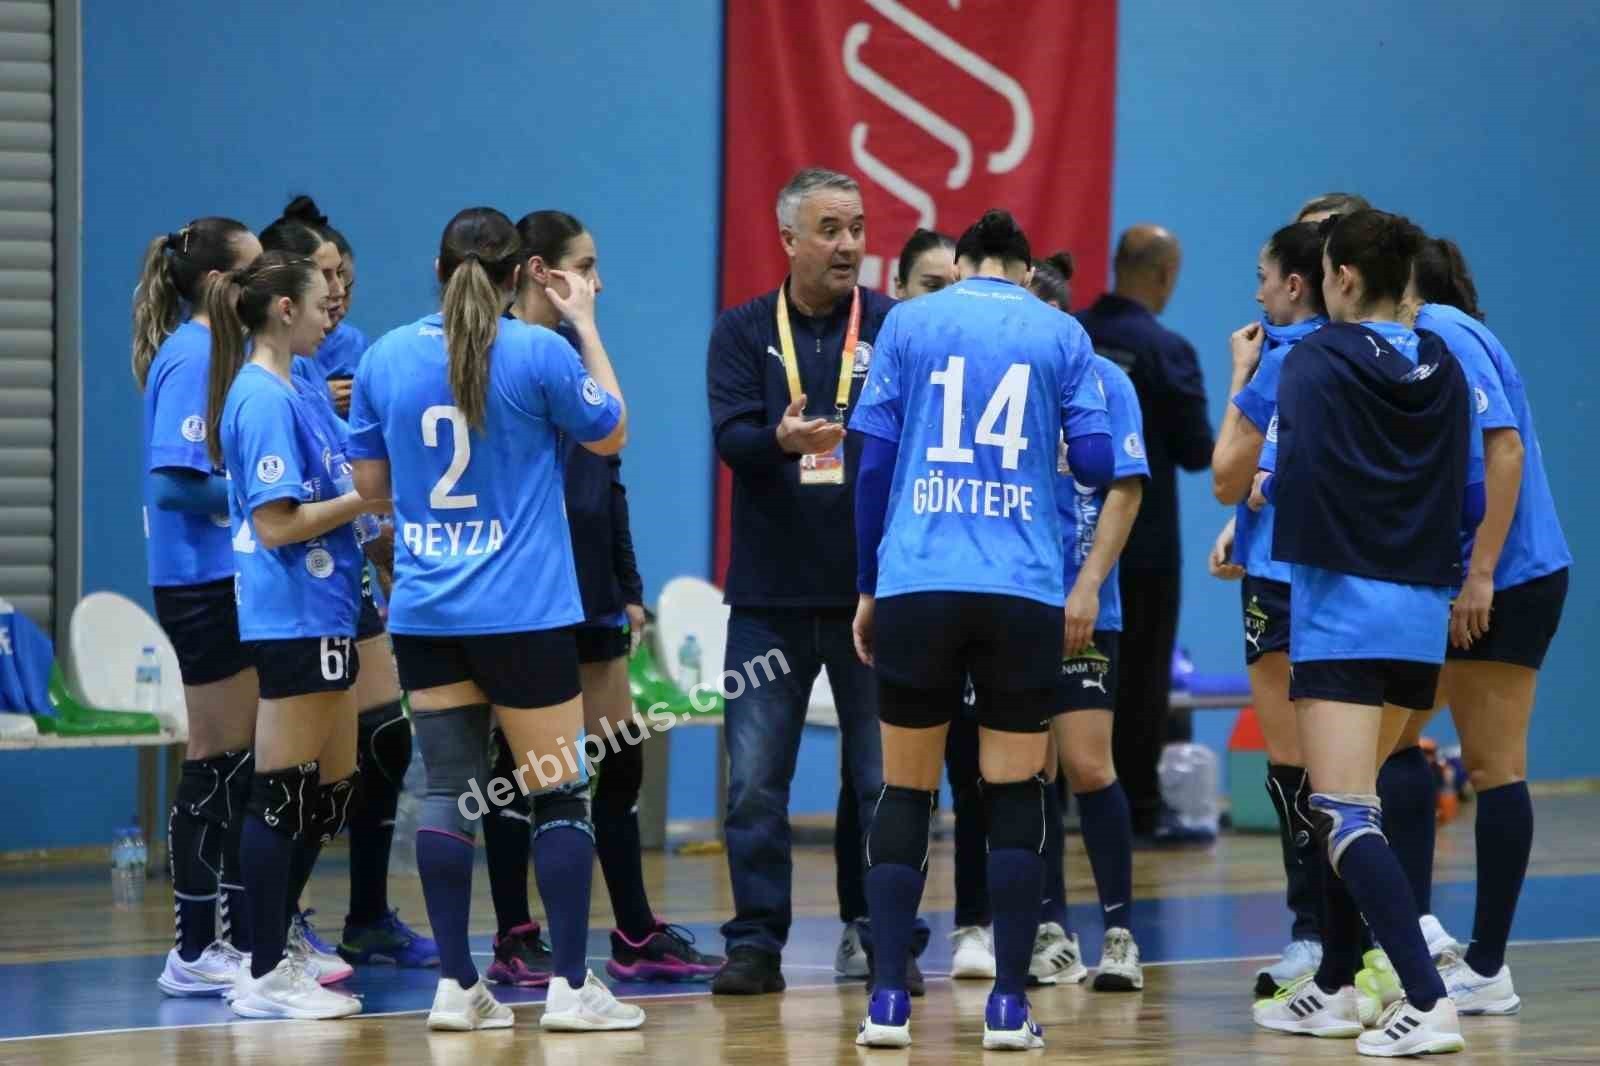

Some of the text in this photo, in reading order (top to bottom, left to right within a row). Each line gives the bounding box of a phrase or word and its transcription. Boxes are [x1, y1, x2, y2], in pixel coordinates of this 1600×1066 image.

[926, 355, 1031, 470] 14
[421, 405, 477, 509] 2
[913, 470, 1033, 521] GÖKTEPE
[403, 519, 505, 557] BEYZA
